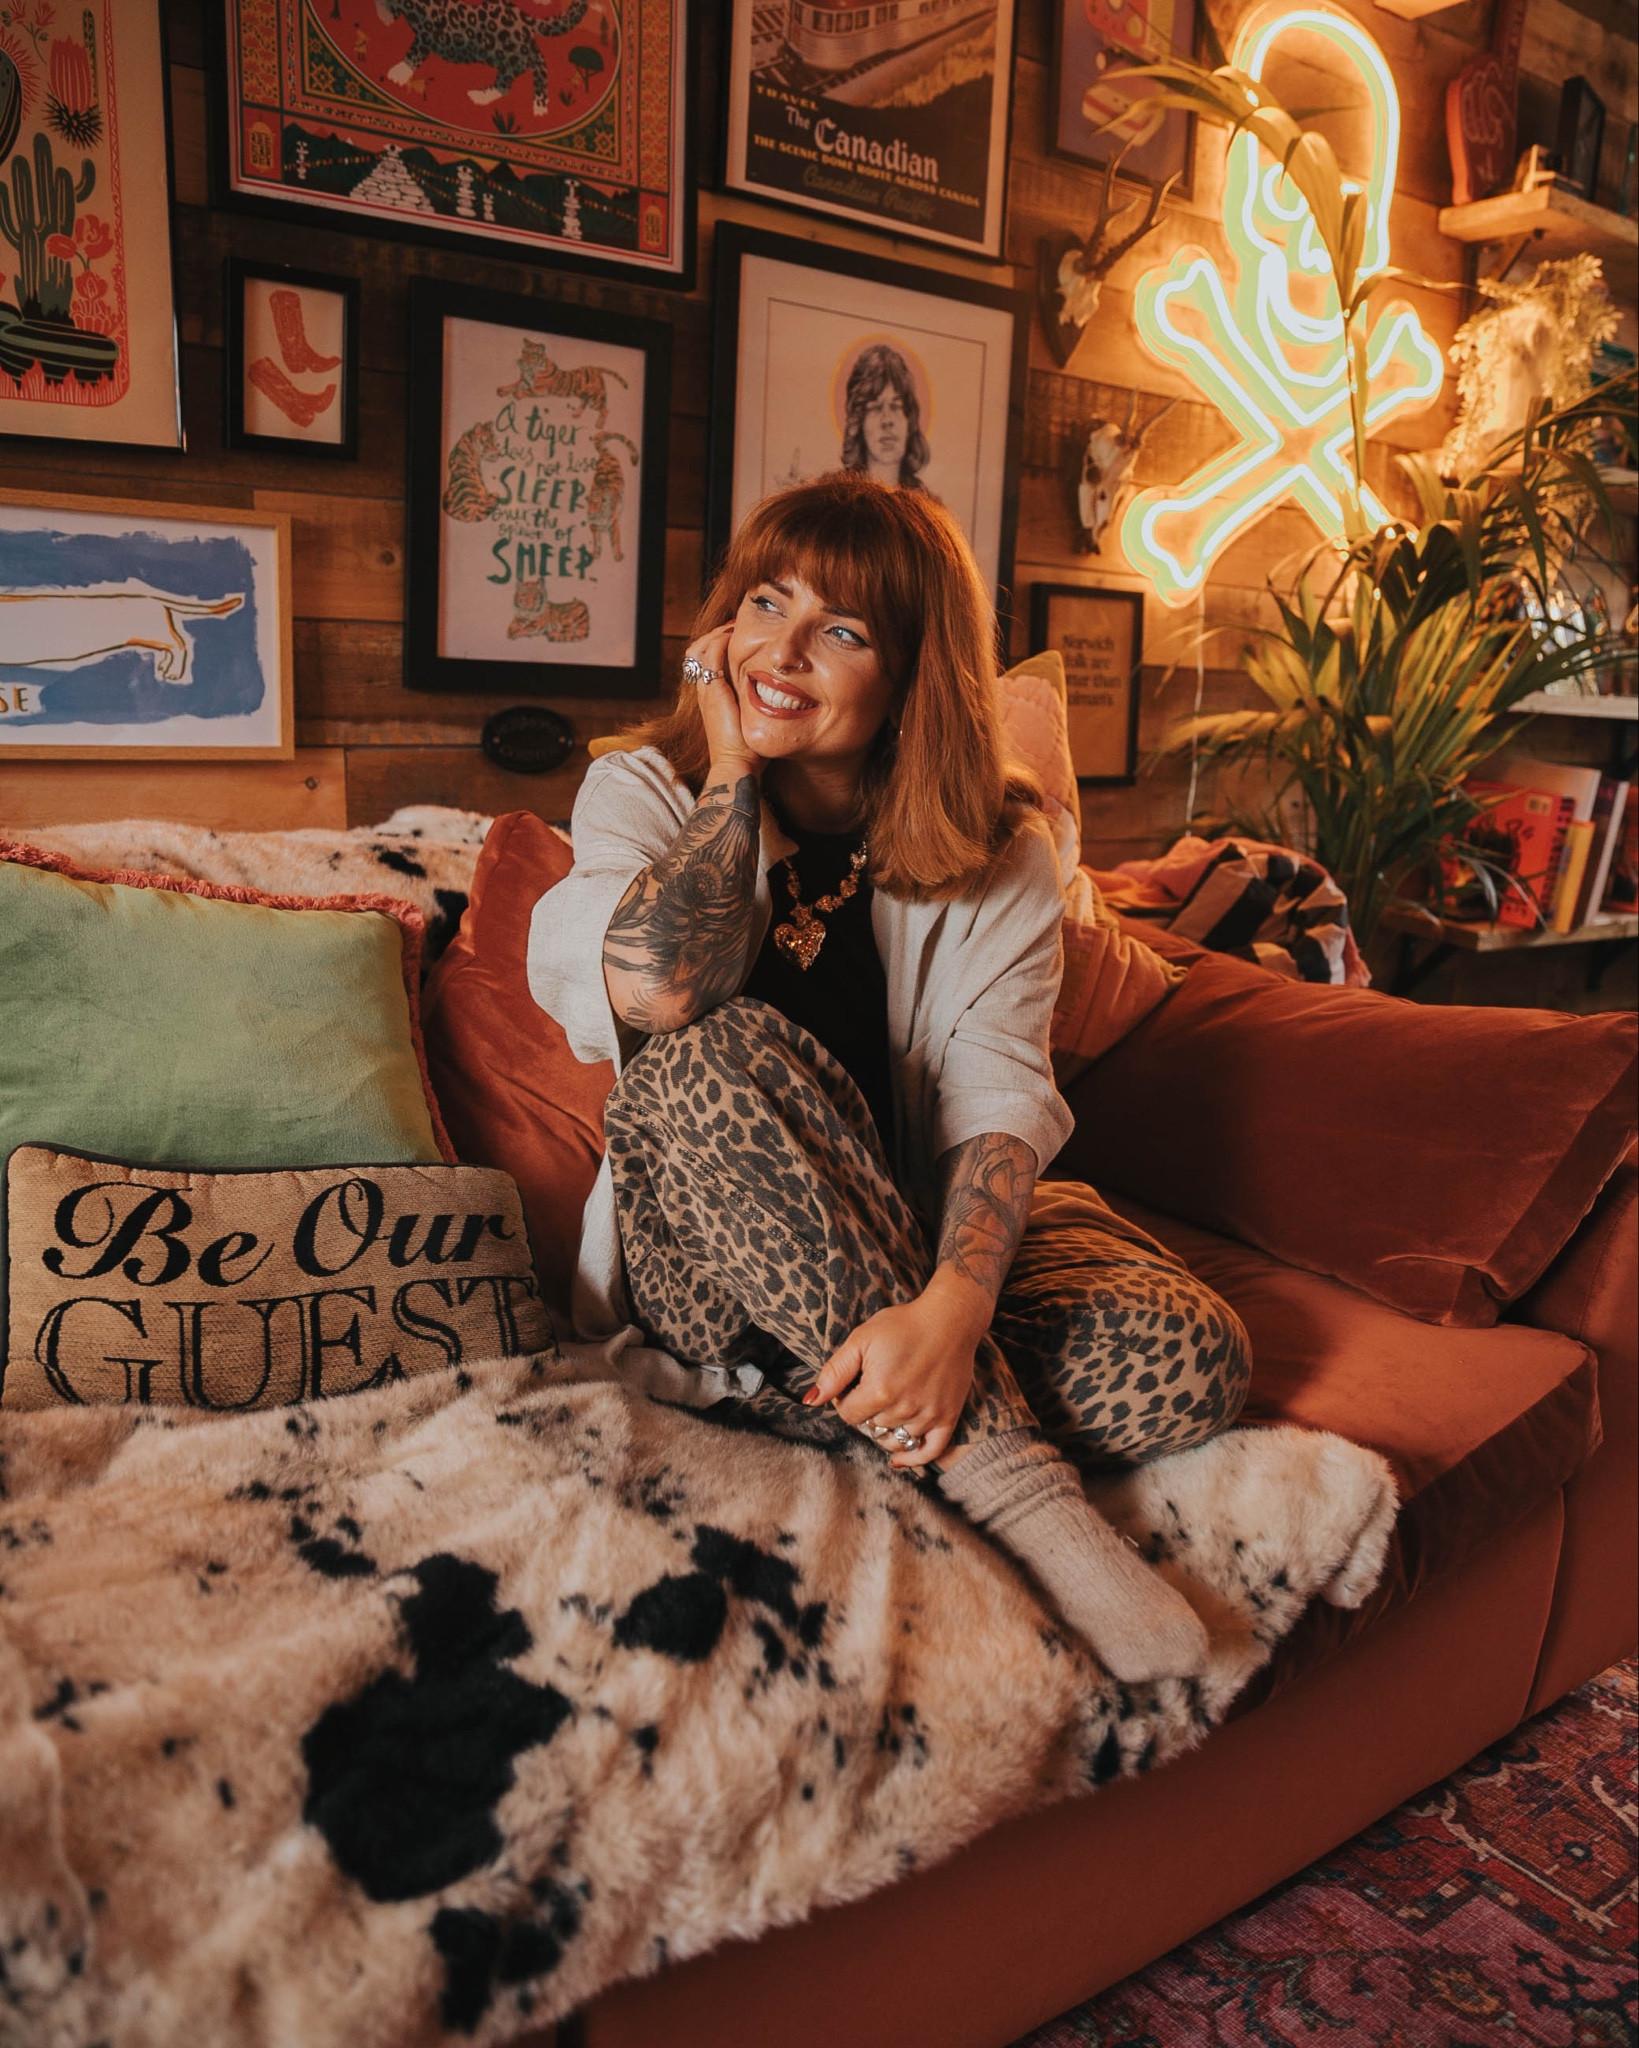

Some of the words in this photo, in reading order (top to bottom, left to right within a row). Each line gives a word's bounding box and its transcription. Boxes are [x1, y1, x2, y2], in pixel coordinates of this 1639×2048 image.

[757, 84, 818, 111] TRAVEL
[754, 133, 775, 150] THE
[779, 141, 818, 161] SCENIC
[785, 105, 811, 130] The
[814, 117, 939, 182] Canadian
[525, 405, 588, 458] tiger
[497, 466, 585, 514] SLEEP
[537, 461, 560, 477] not
[532, 508, 558, 529] the
[42, 1182, 275, 1287] Be
[294, 1178, 517, 1277] Our
[35, 1276, 534, 1412] GUEST
